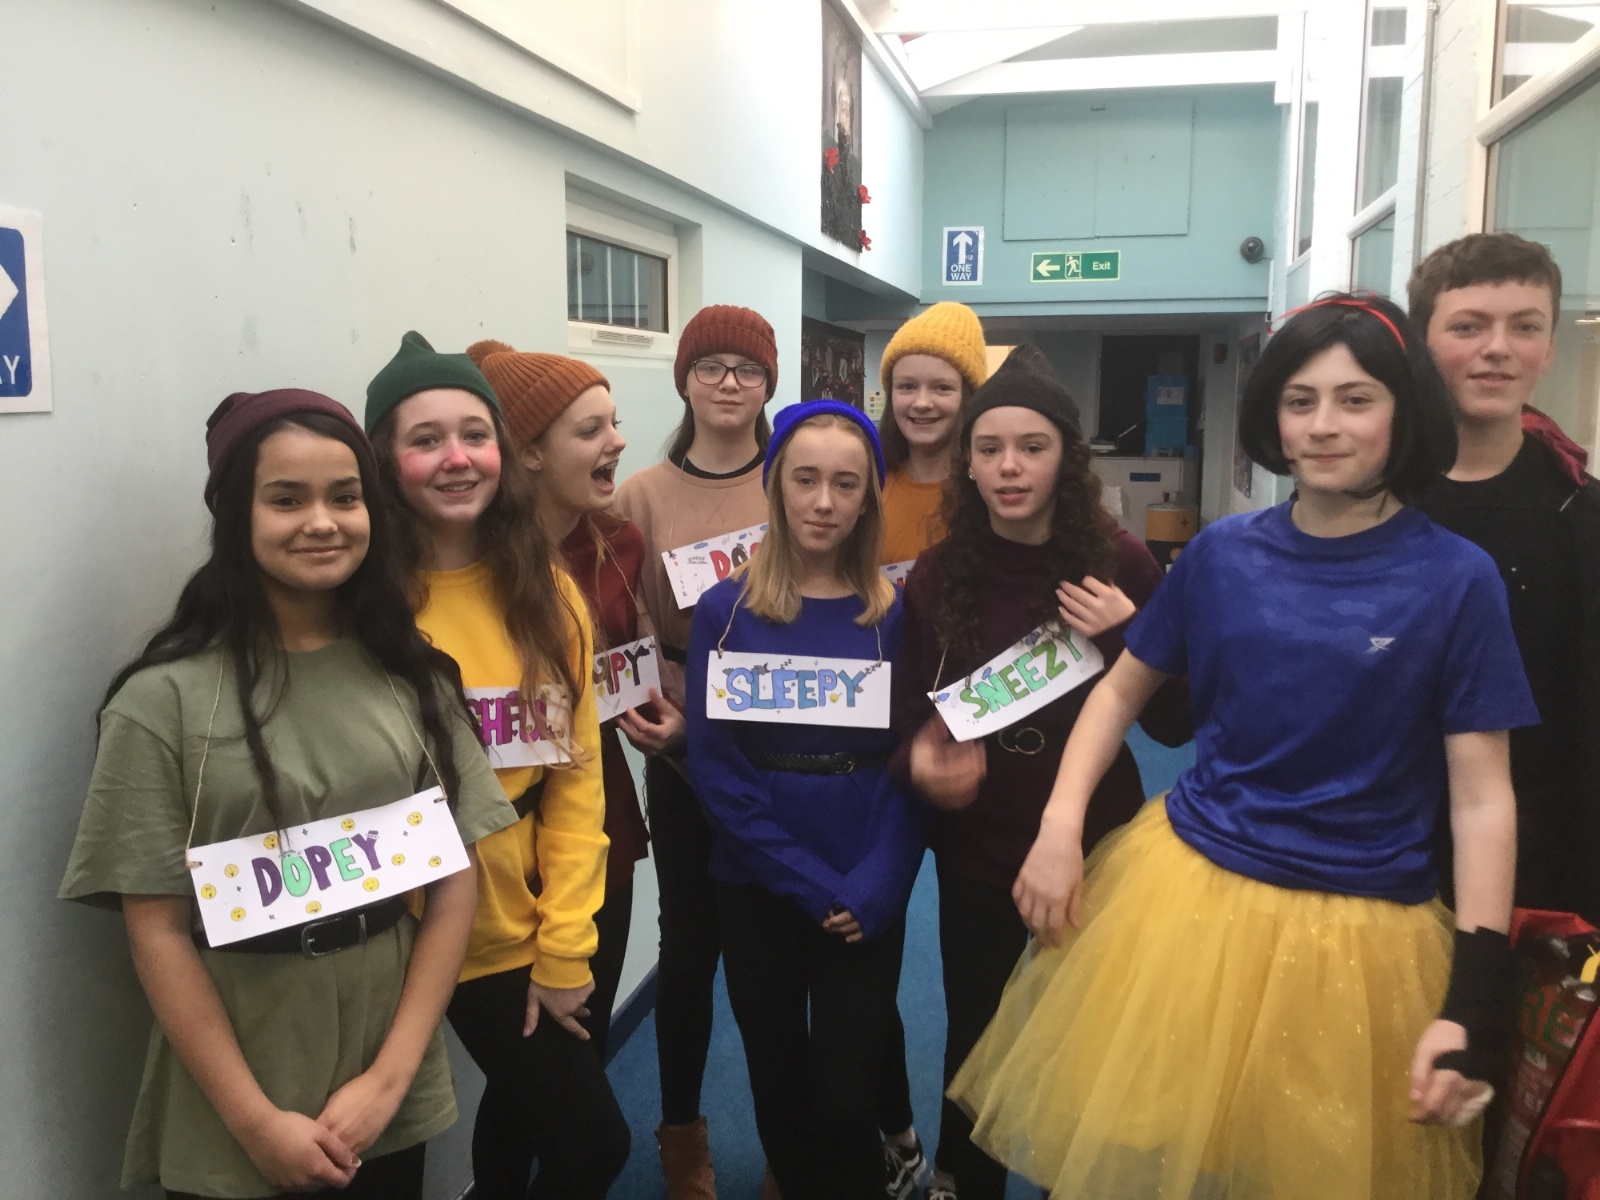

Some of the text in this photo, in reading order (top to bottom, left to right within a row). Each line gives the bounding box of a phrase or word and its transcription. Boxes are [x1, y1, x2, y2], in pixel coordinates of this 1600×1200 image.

[950, 264, 973, 273] ONE
[950, 272, 972, 281] WAY
[1092, 261, 1111, 271] Exit
[0, 355, 20, 384] Y
[960, 625, 1082, 719] SNEEZY
[726, 667, 866, 712] SLEEPY
[252, 830, 381, 907] DOPEY
